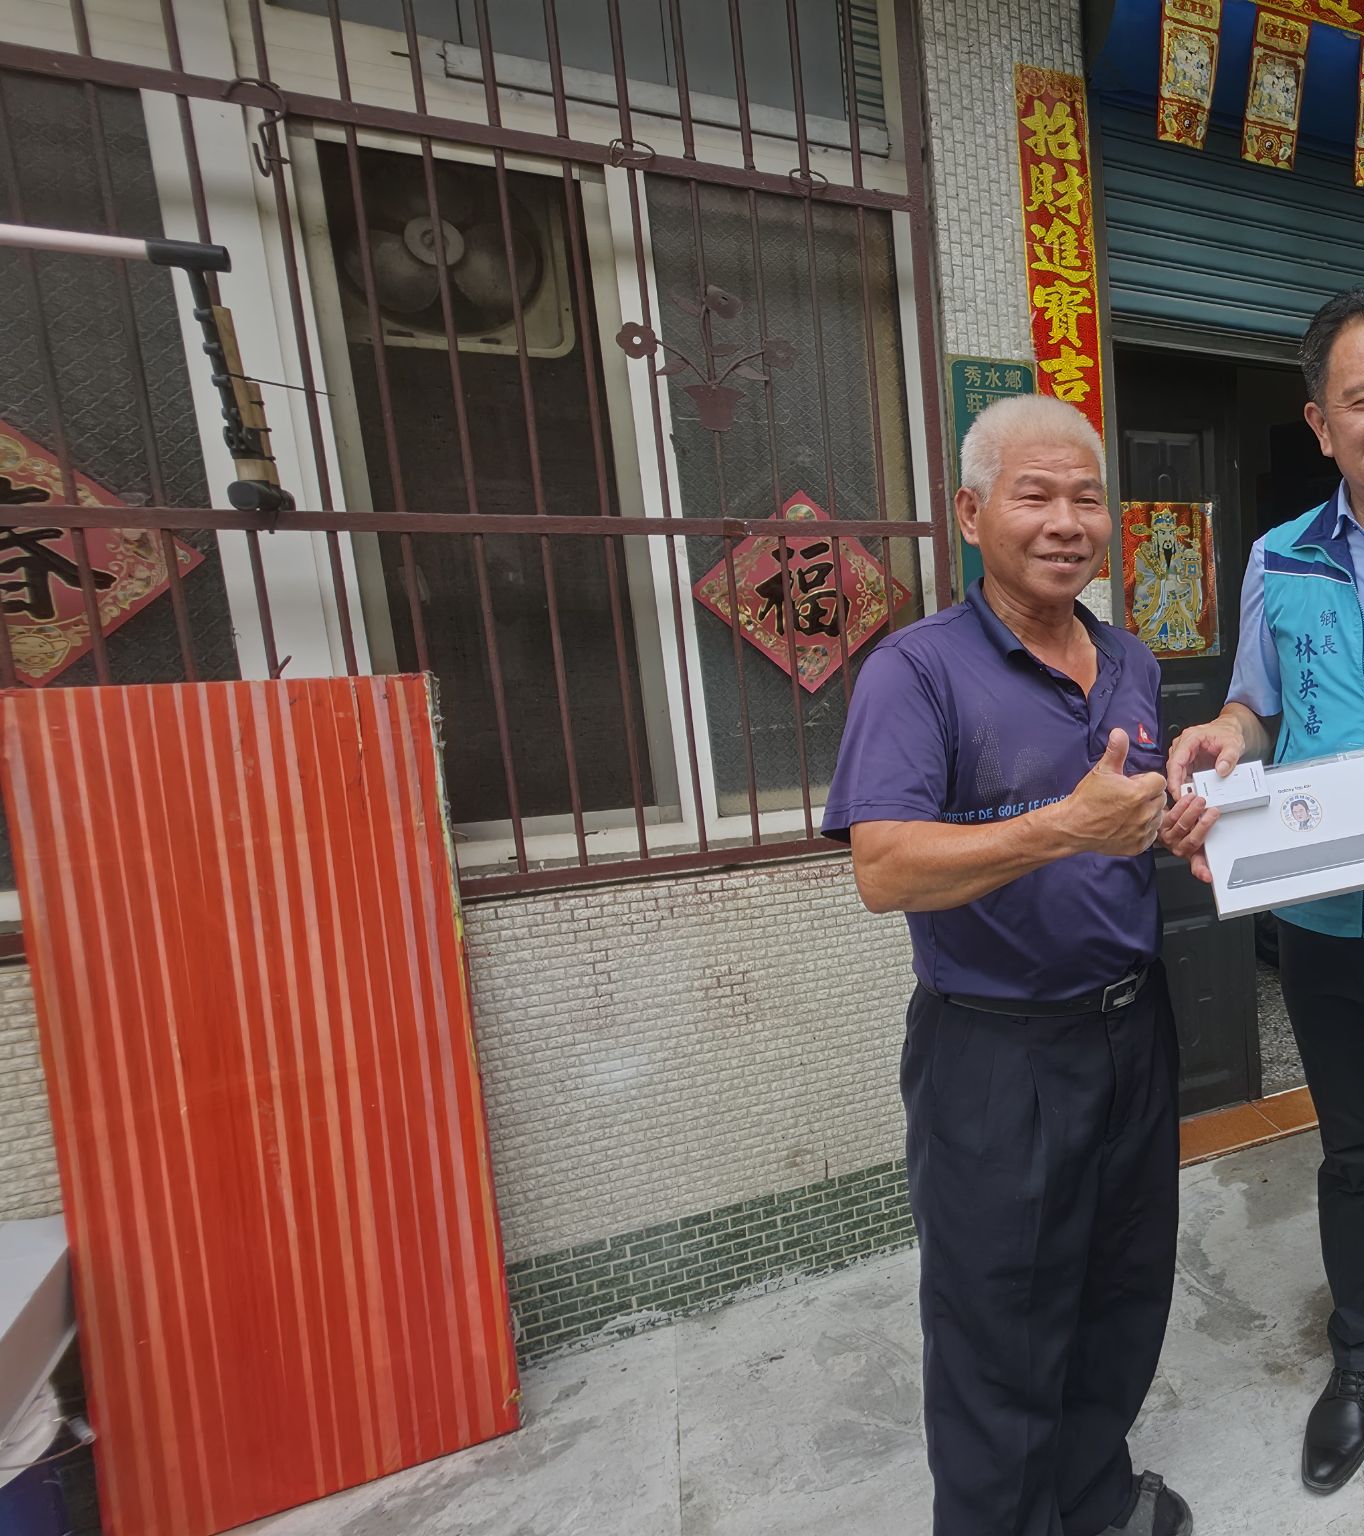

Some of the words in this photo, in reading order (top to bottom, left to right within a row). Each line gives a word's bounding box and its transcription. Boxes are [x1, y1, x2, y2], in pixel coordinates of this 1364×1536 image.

[964, 365, 1022, 391] 秀水鄉
[754, 541, 851, 638] 福
[1319, 608, 1338, 655] 鄉長
[1294, 633, 1323, 736] 林英嘉
[978, 807, 994, 820] DE
[998, 802, 1025, 817] GOLF
